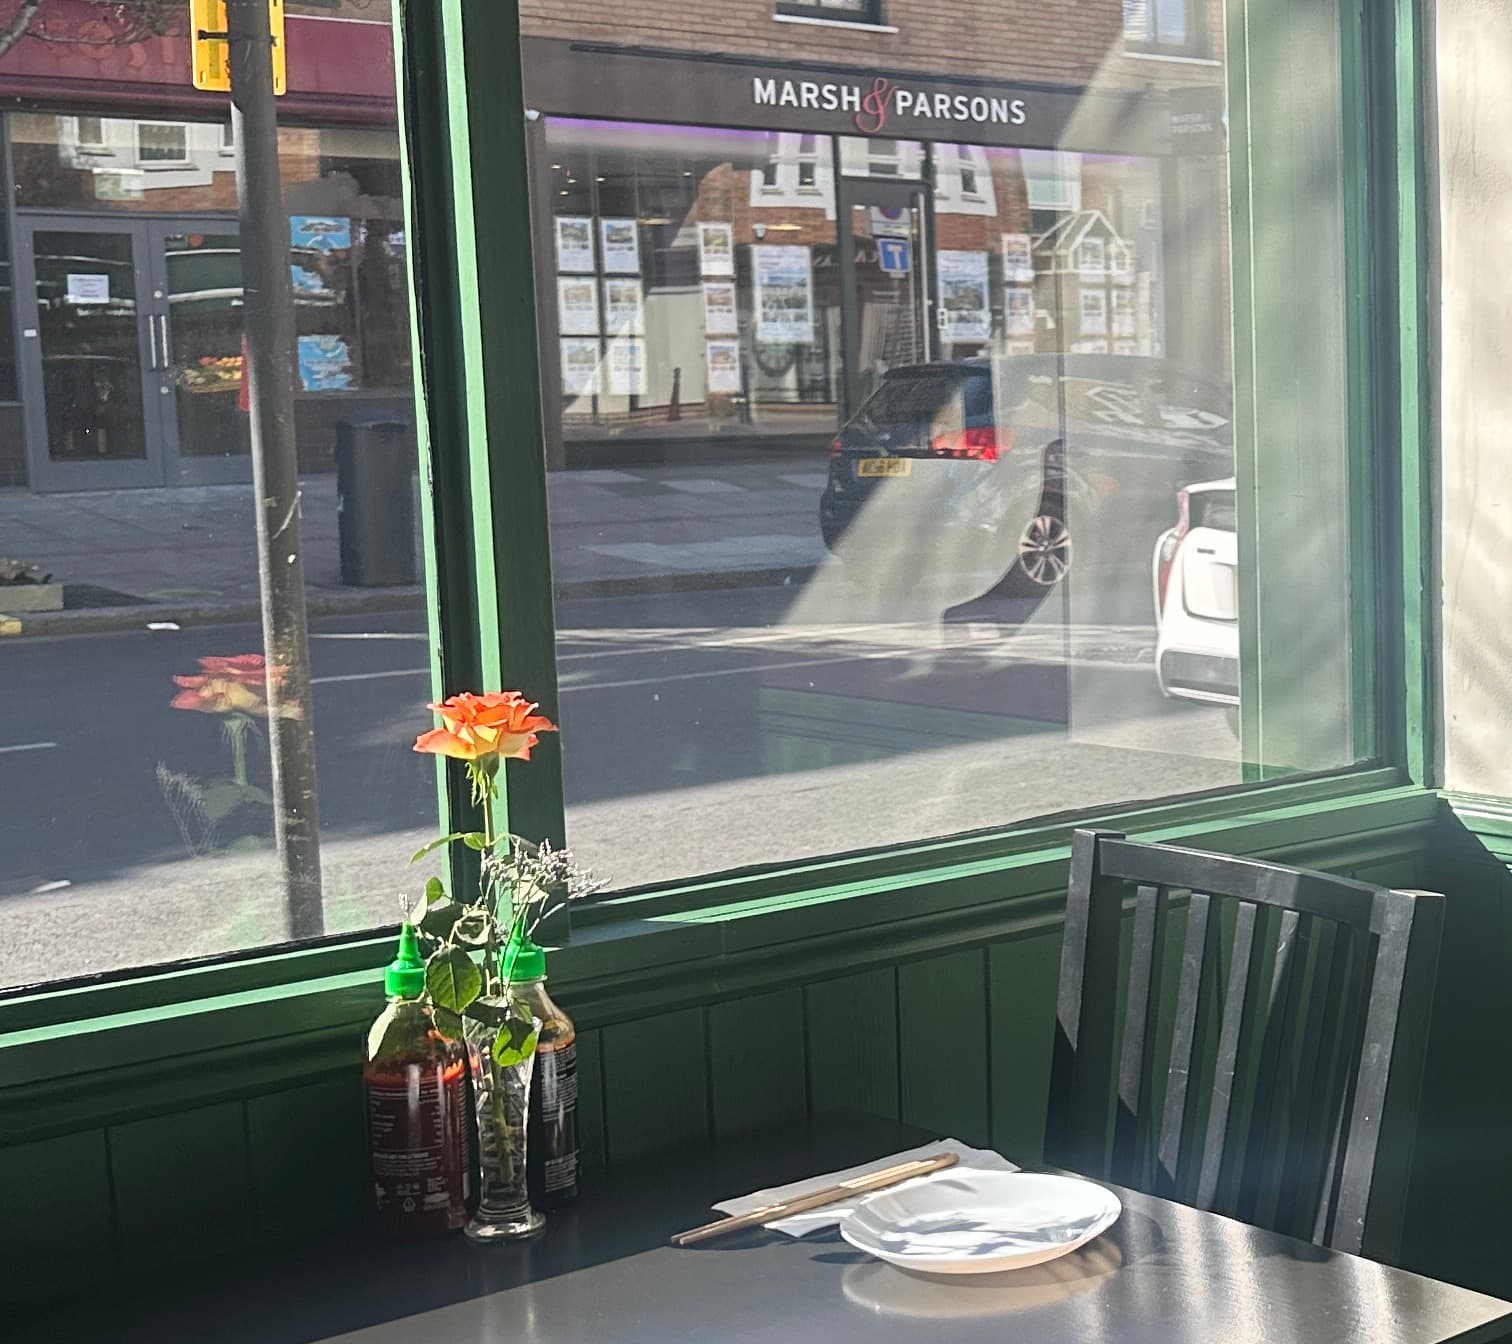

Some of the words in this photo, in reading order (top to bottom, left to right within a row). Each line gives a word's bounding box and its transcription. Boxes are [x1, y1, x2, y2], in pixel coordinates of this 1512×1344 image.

[753, 77, 861, 112] MARSH
[855, 76, 899, 134] &
[895, 89, 1027, 125] PARSONS
